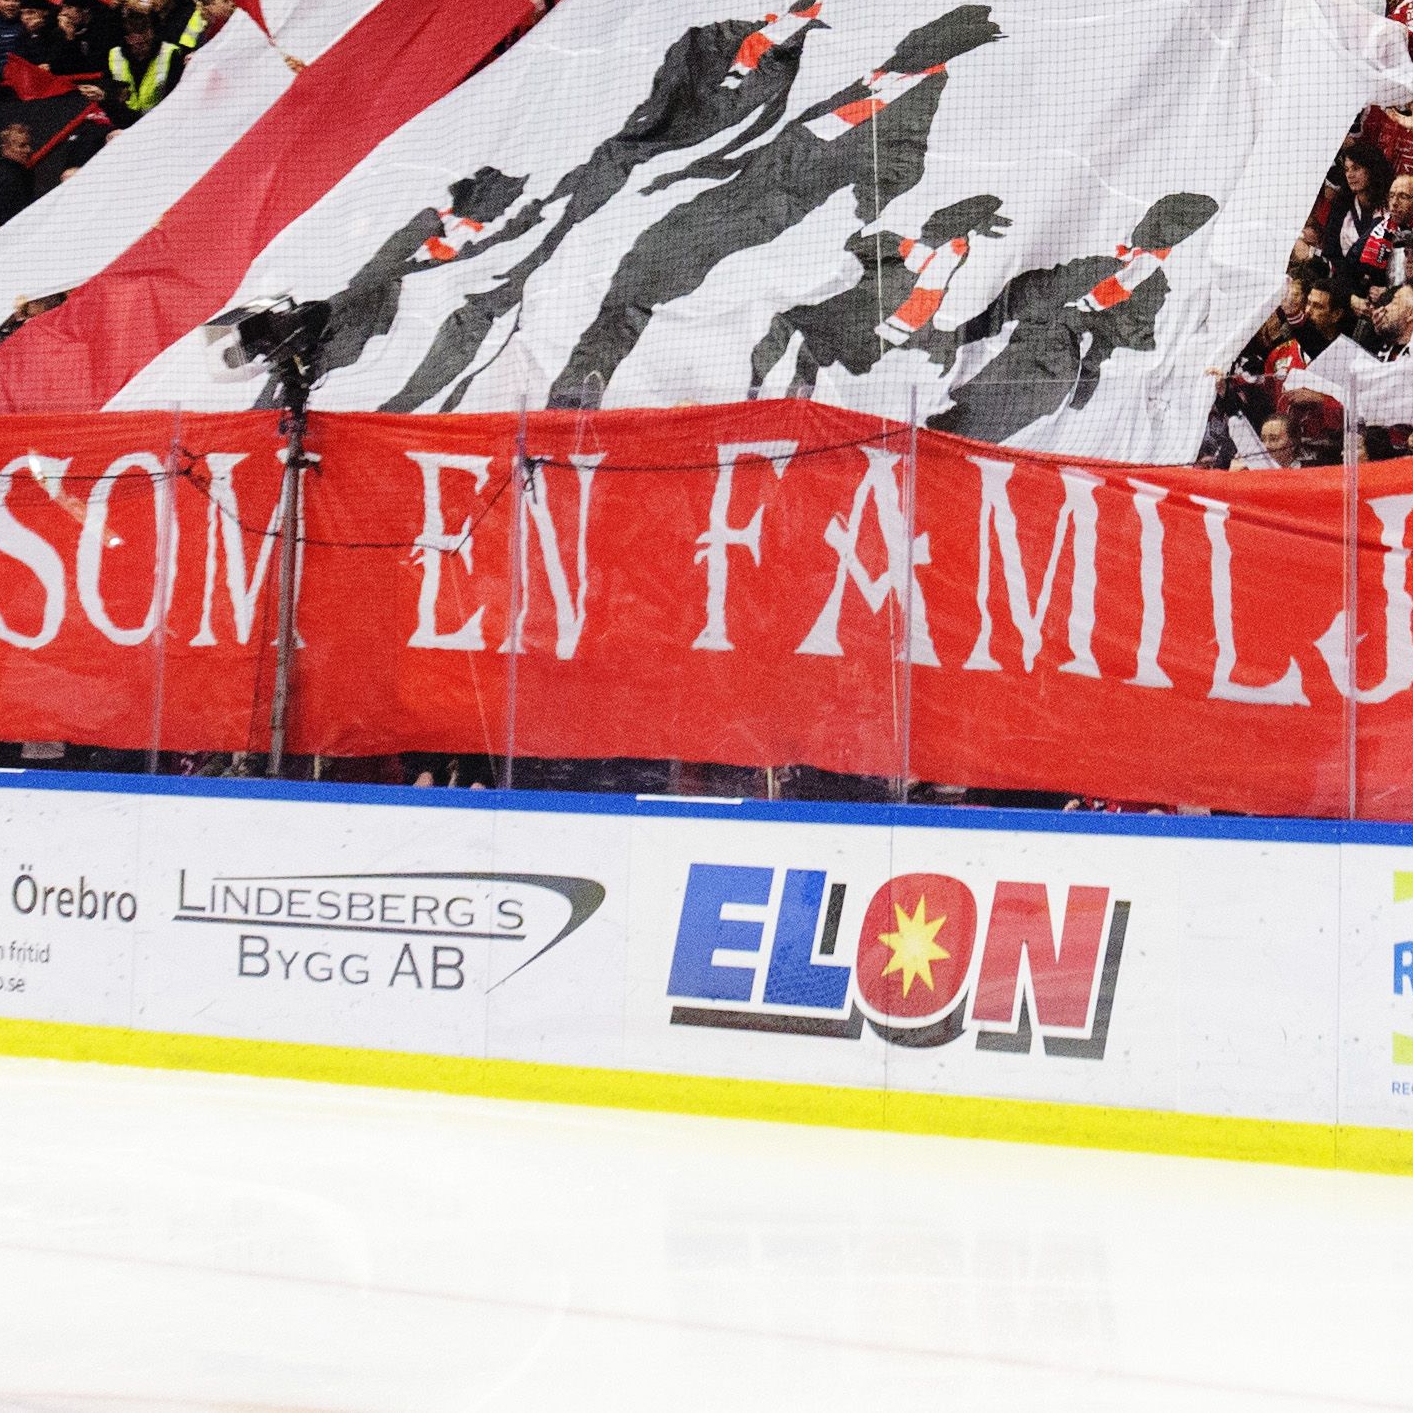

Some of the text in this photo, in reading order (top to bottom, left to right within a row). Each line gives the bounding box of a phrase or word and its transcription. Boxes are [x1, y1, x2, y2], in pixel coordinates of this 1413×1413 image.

[399, 450, 607, 661] EN
[11, 863, 138, 924] Örebro
[9, 938, 51, 964] fritid
[387, 942, 466, 992] AB
[666, 862, 1122, 1049] ELON
